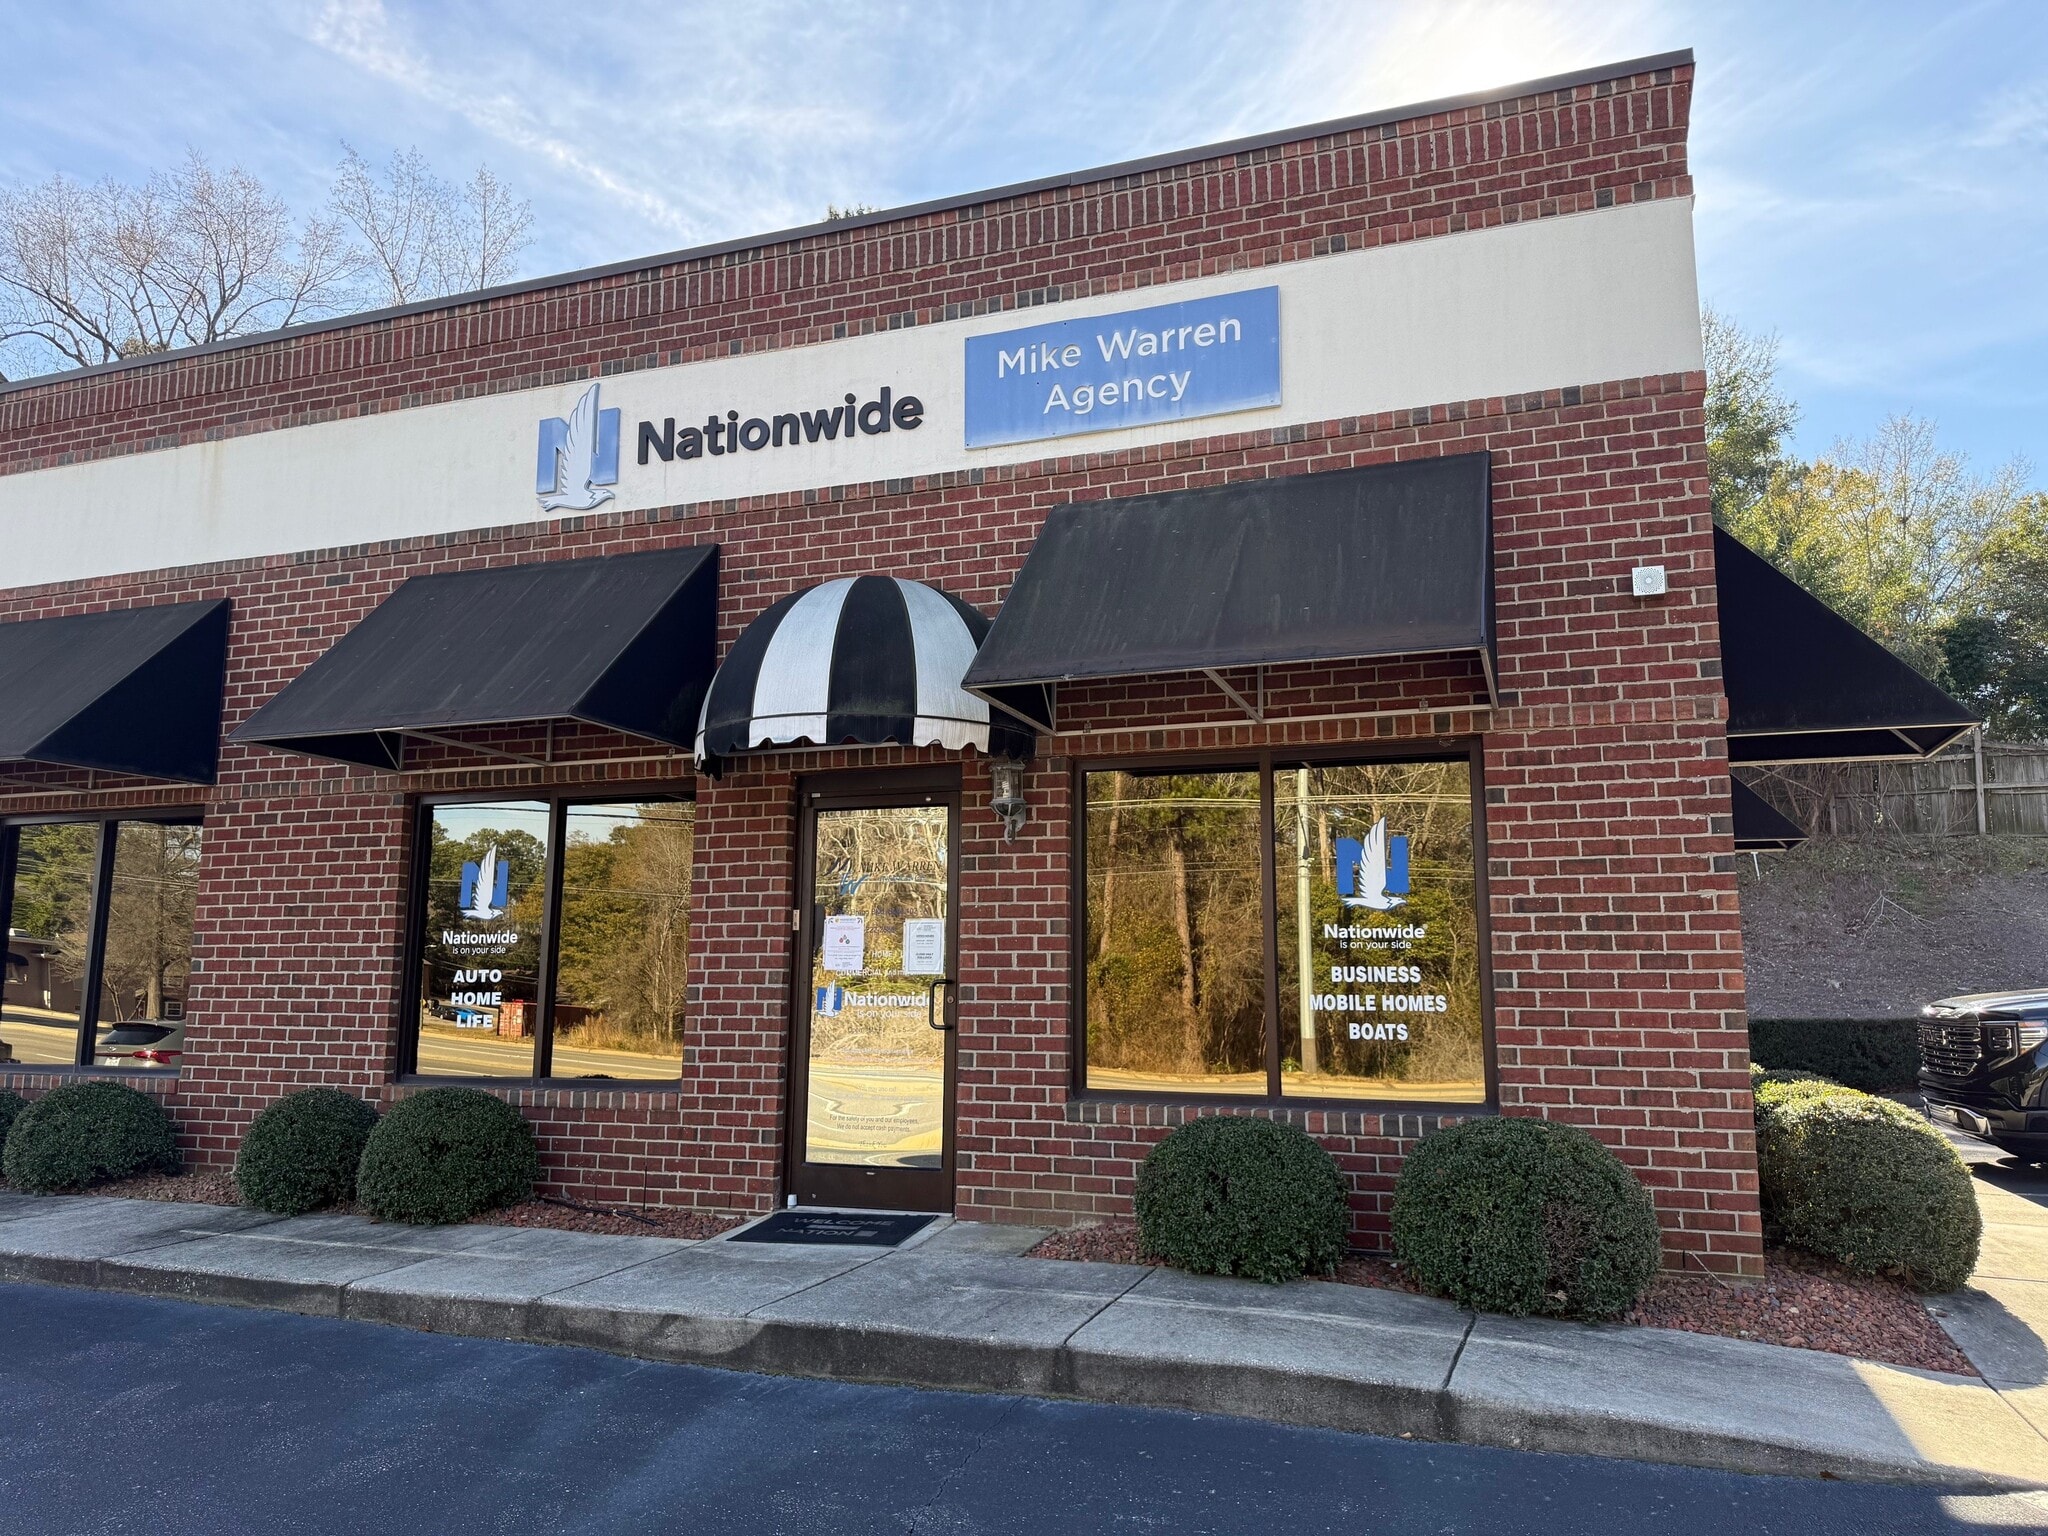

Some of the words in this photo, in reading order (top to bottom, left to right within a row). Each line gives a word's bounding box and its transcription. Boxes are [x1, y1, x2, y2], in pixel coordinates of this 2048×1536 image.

[997, 339, 1082, 381] Mike
[1097, 316, 1243, 362] Warren
[1043, 368, 1192, 415] Agency
[637, 386, 925, 465] Nationwide
[892, 860, 941, 873] WARREN
[442, 930, 518, 945] Nationwide
[1323, 923, 1426, 939] Nationwide
[452, 946, 459, 954] is
[471, 947, 489, 956] your
[490, 945, 506, 954] side
[1339, 940, 1348, 949] is
[1350, 941, 1363, 949] on
[1365, 941, 1389, 951] your
[1391, 940, 1412, 949] side
[453, 969, 502, 983] AUTO
[1331, 965, 1422, 983] BUSINESS
[451, 992, 502, 1006] HOME
[1309, 994, 1377, 1011] MOBILE
[1382, 994, 1447, 1012] HOMES
[456, 1014, 494, 1028] LIFE
[1349, 1023, 1409, 1041] BOATS
[846, 1115, 859, 1123] safety
[795, 1217, 896, 1226] WELCOME
